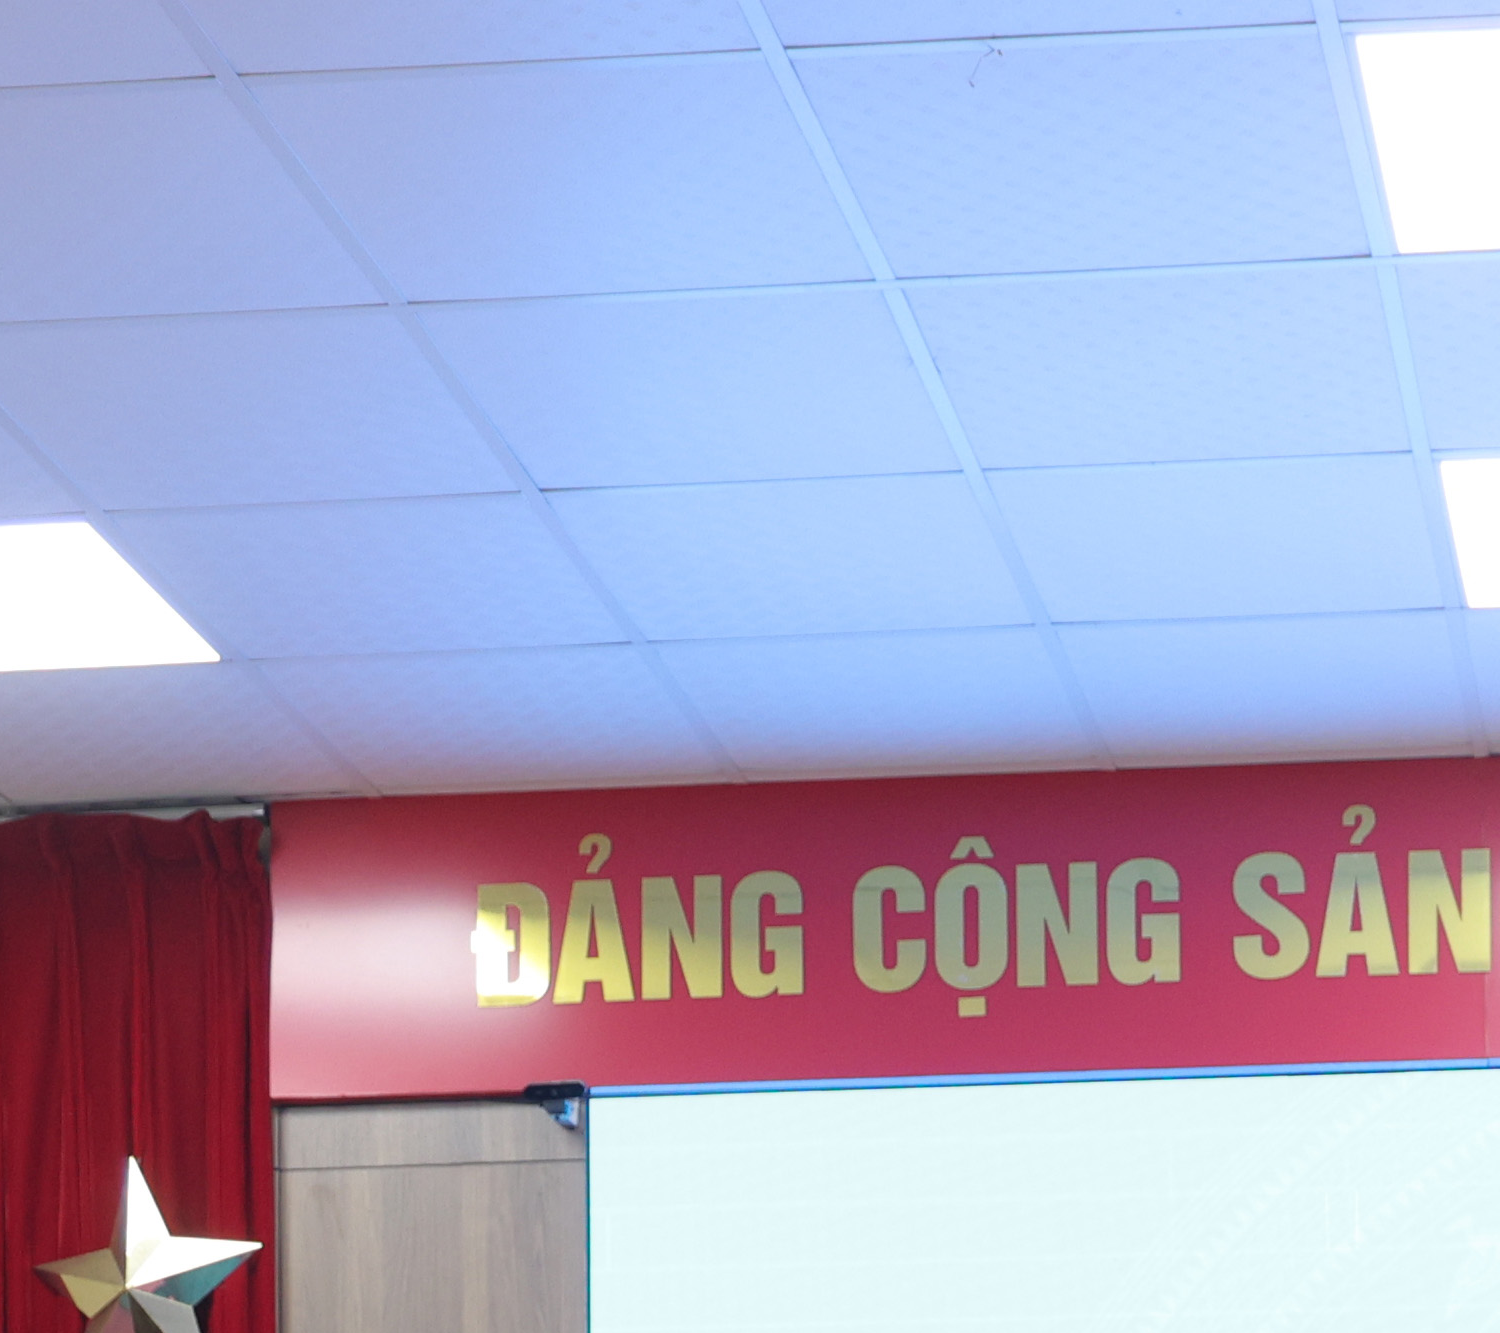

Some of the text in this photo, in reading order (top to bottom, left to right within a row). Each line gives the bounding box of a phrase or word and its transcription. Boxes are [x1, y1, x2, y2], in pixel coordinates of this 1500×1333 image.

[471, 834, 804, 1006] ĐẢNG
[853, 837, 1183, 1017] CỘNG
[1231, 804, 1492, 980] SẢN
